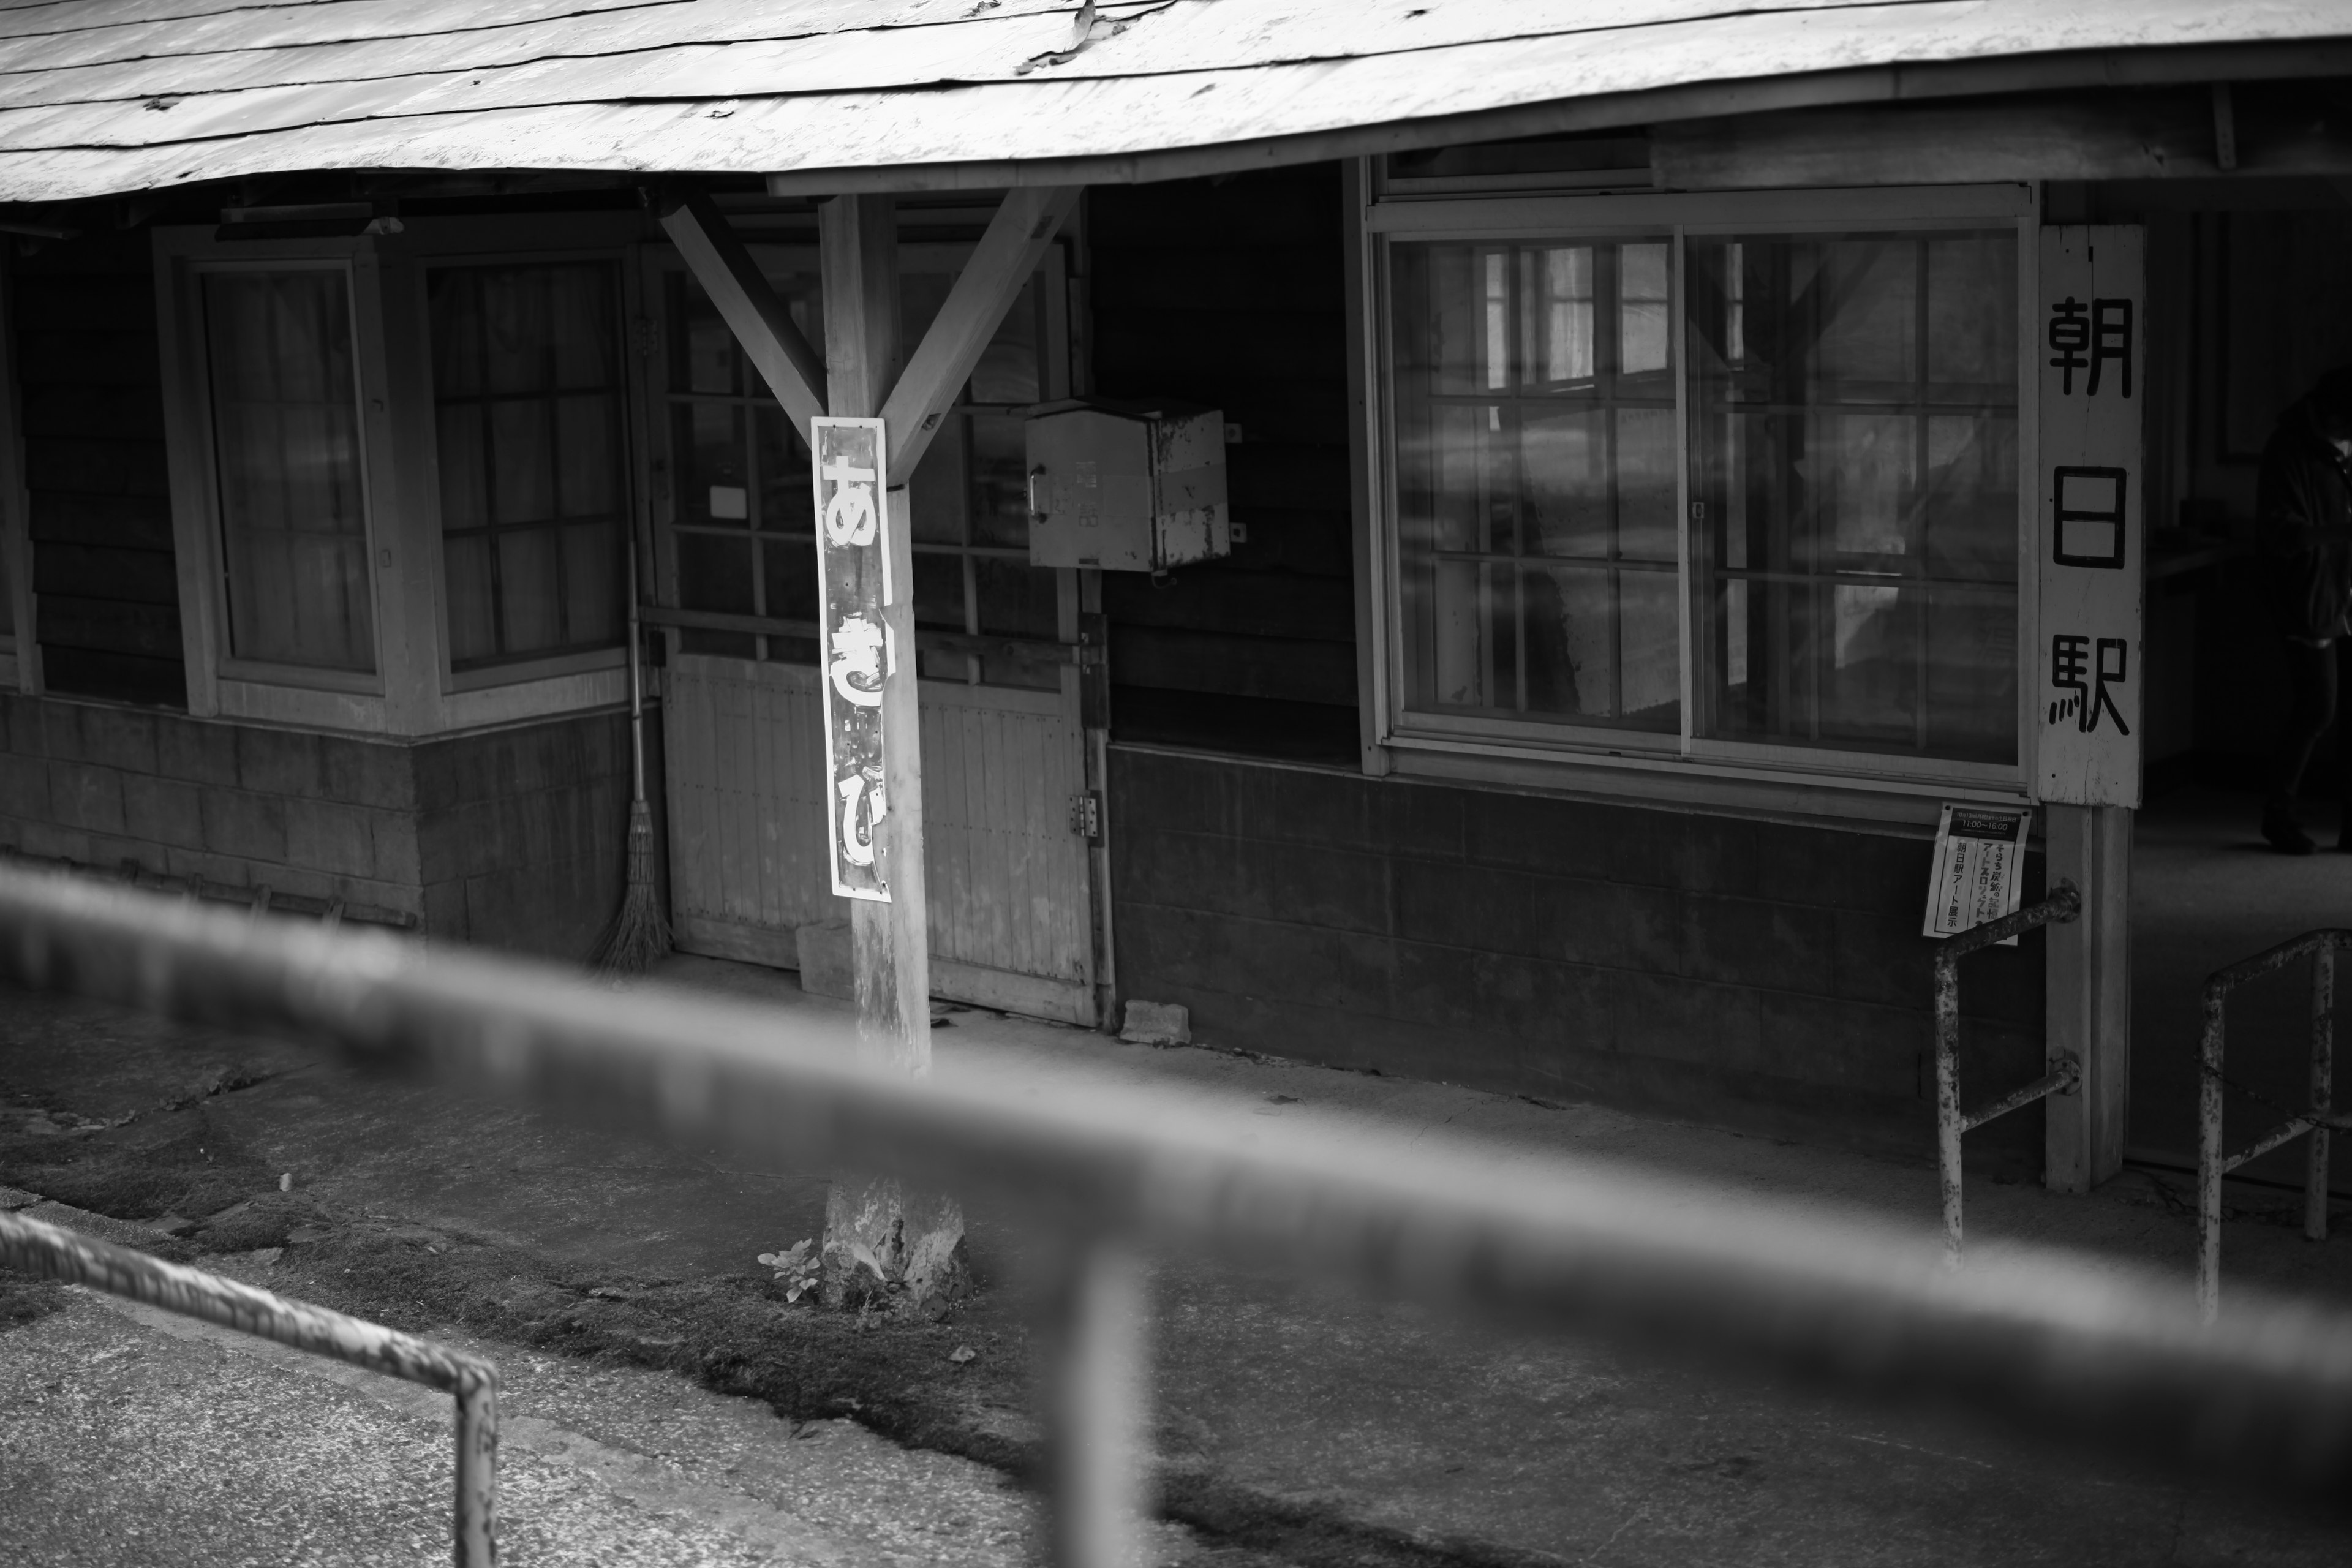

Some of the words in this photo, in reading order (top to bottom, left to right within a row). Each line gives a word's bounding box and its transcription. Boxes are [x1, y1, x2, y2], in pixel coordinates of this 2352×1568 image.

[2049, 296, 2133, 736] 朝日駅
[1947, 843, 1967, 927] 朝日駅アート展示
